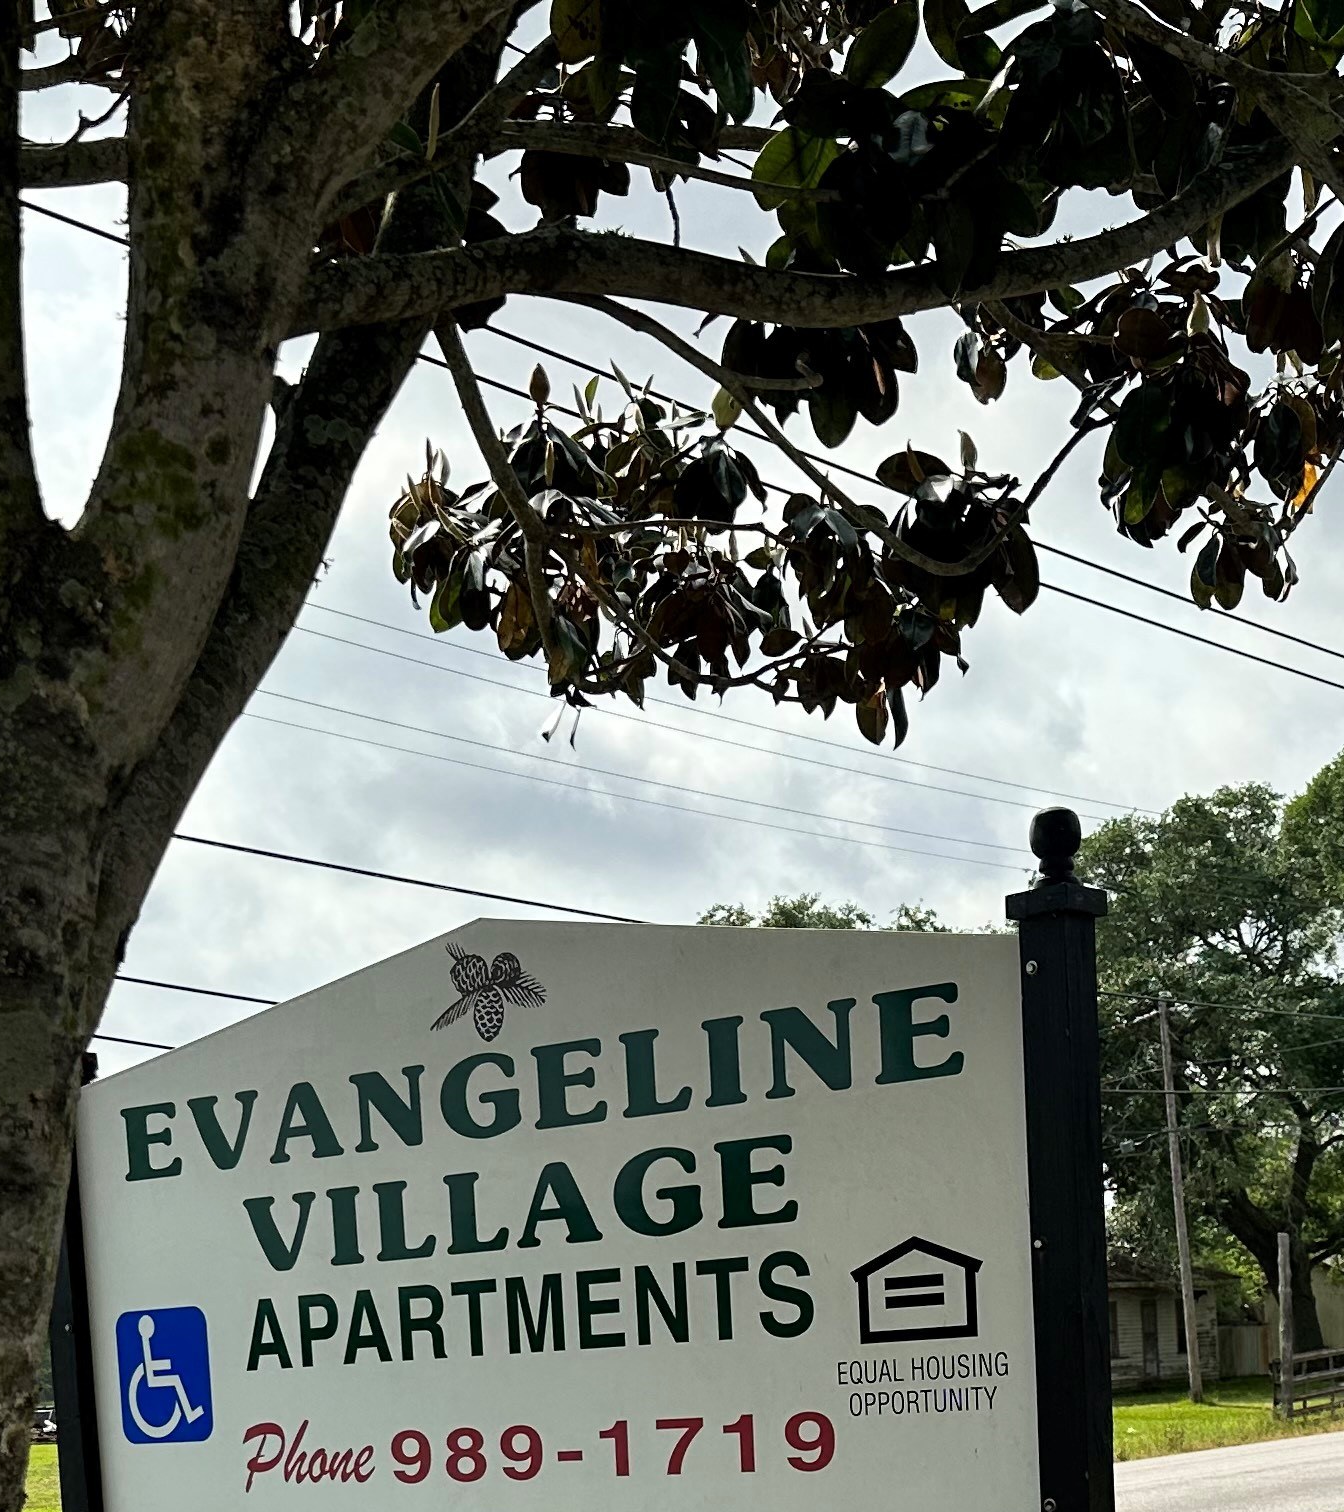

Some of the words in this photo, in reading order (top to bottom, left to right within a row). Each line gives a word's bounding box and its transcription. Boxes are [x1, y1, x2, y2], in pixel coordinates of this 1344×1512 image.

[119, 981, 966, 1182] EVANGELINE
[243, 1133, 800, 1272] VILLAGE
[246, 1250, 815, 1372] APARTMENTS
[837, 1358, 904, 1385] EQUAL
[911, 1351, 1009, 1381] HOUSING
[849, 1385, 998, 1417] OPPORTUNITY
[245, 1419, 374, 1493] Phone
[391, 1411, 836, 1484] 989-1719
